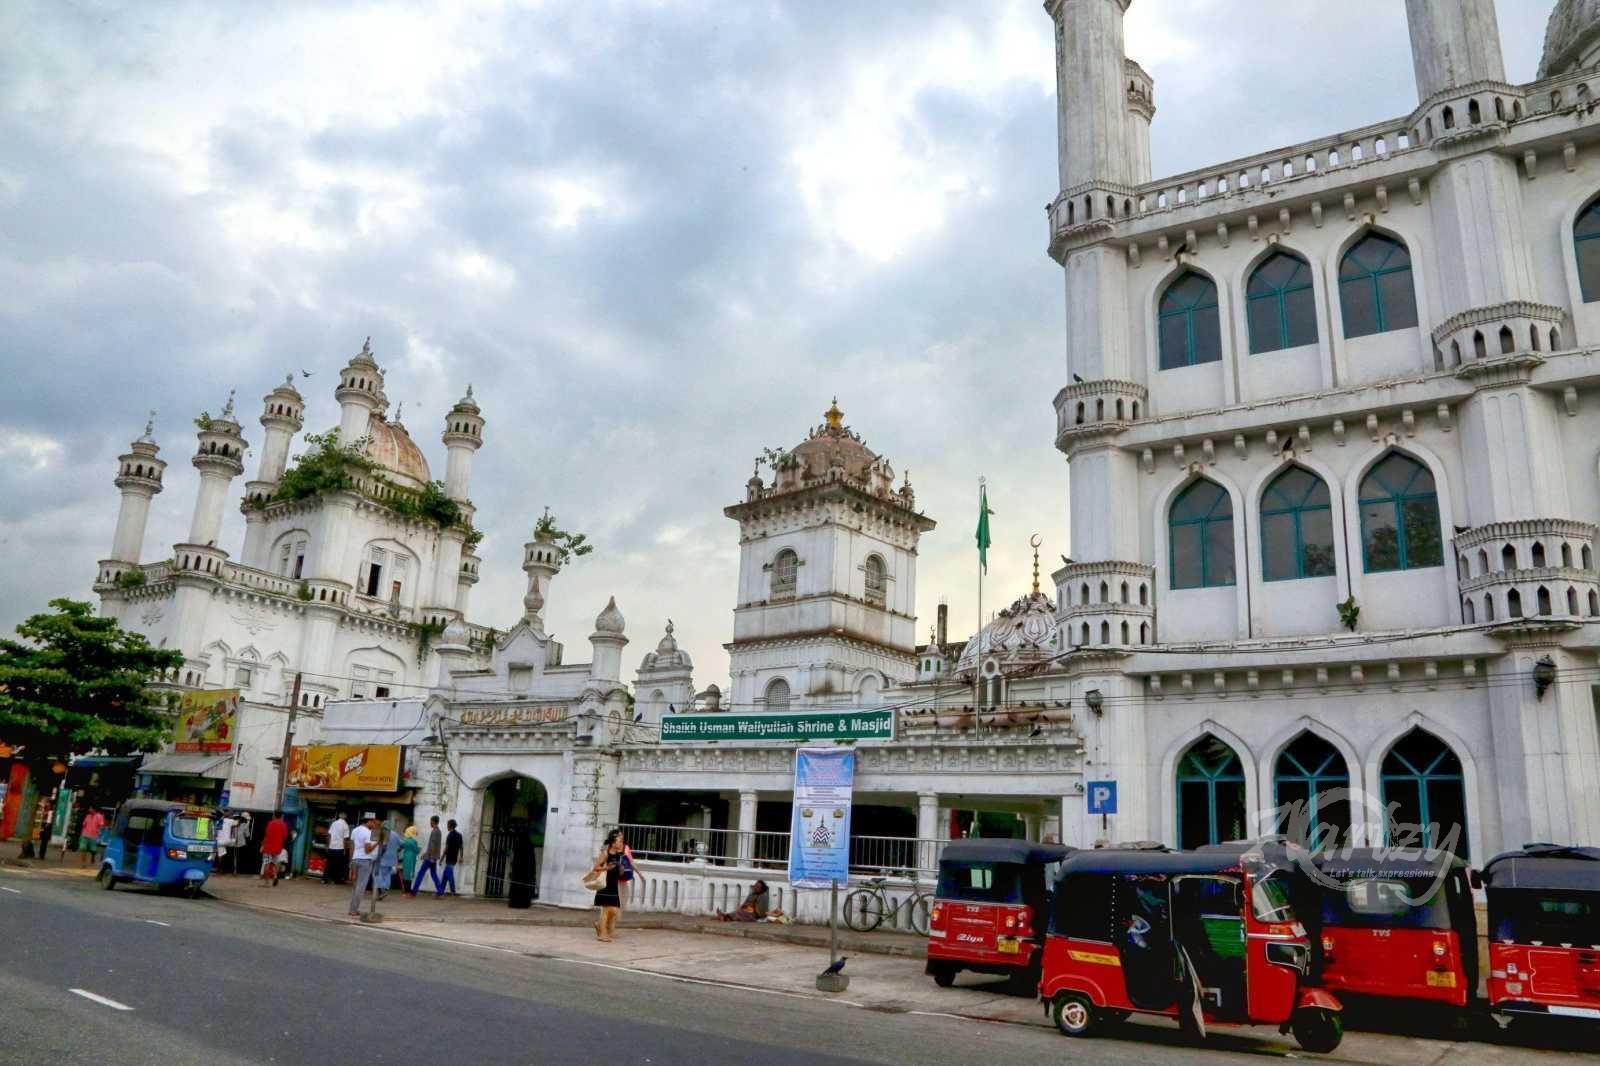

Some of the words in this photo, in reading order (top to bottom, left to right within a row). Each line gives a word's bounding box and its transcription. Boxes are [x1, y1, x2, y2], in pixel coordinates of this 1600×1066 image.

[663, 722, 697, 734] Shaikh
[699, 721, 735, 733] Usman
[797, 720, 834, 733] Shrine
[838, 719, 847, 731] &
[851, 717, 892, 733] Masjid
[1093, 787, 1111, 809] P
[1371, 928, 1391, 937] TVS
